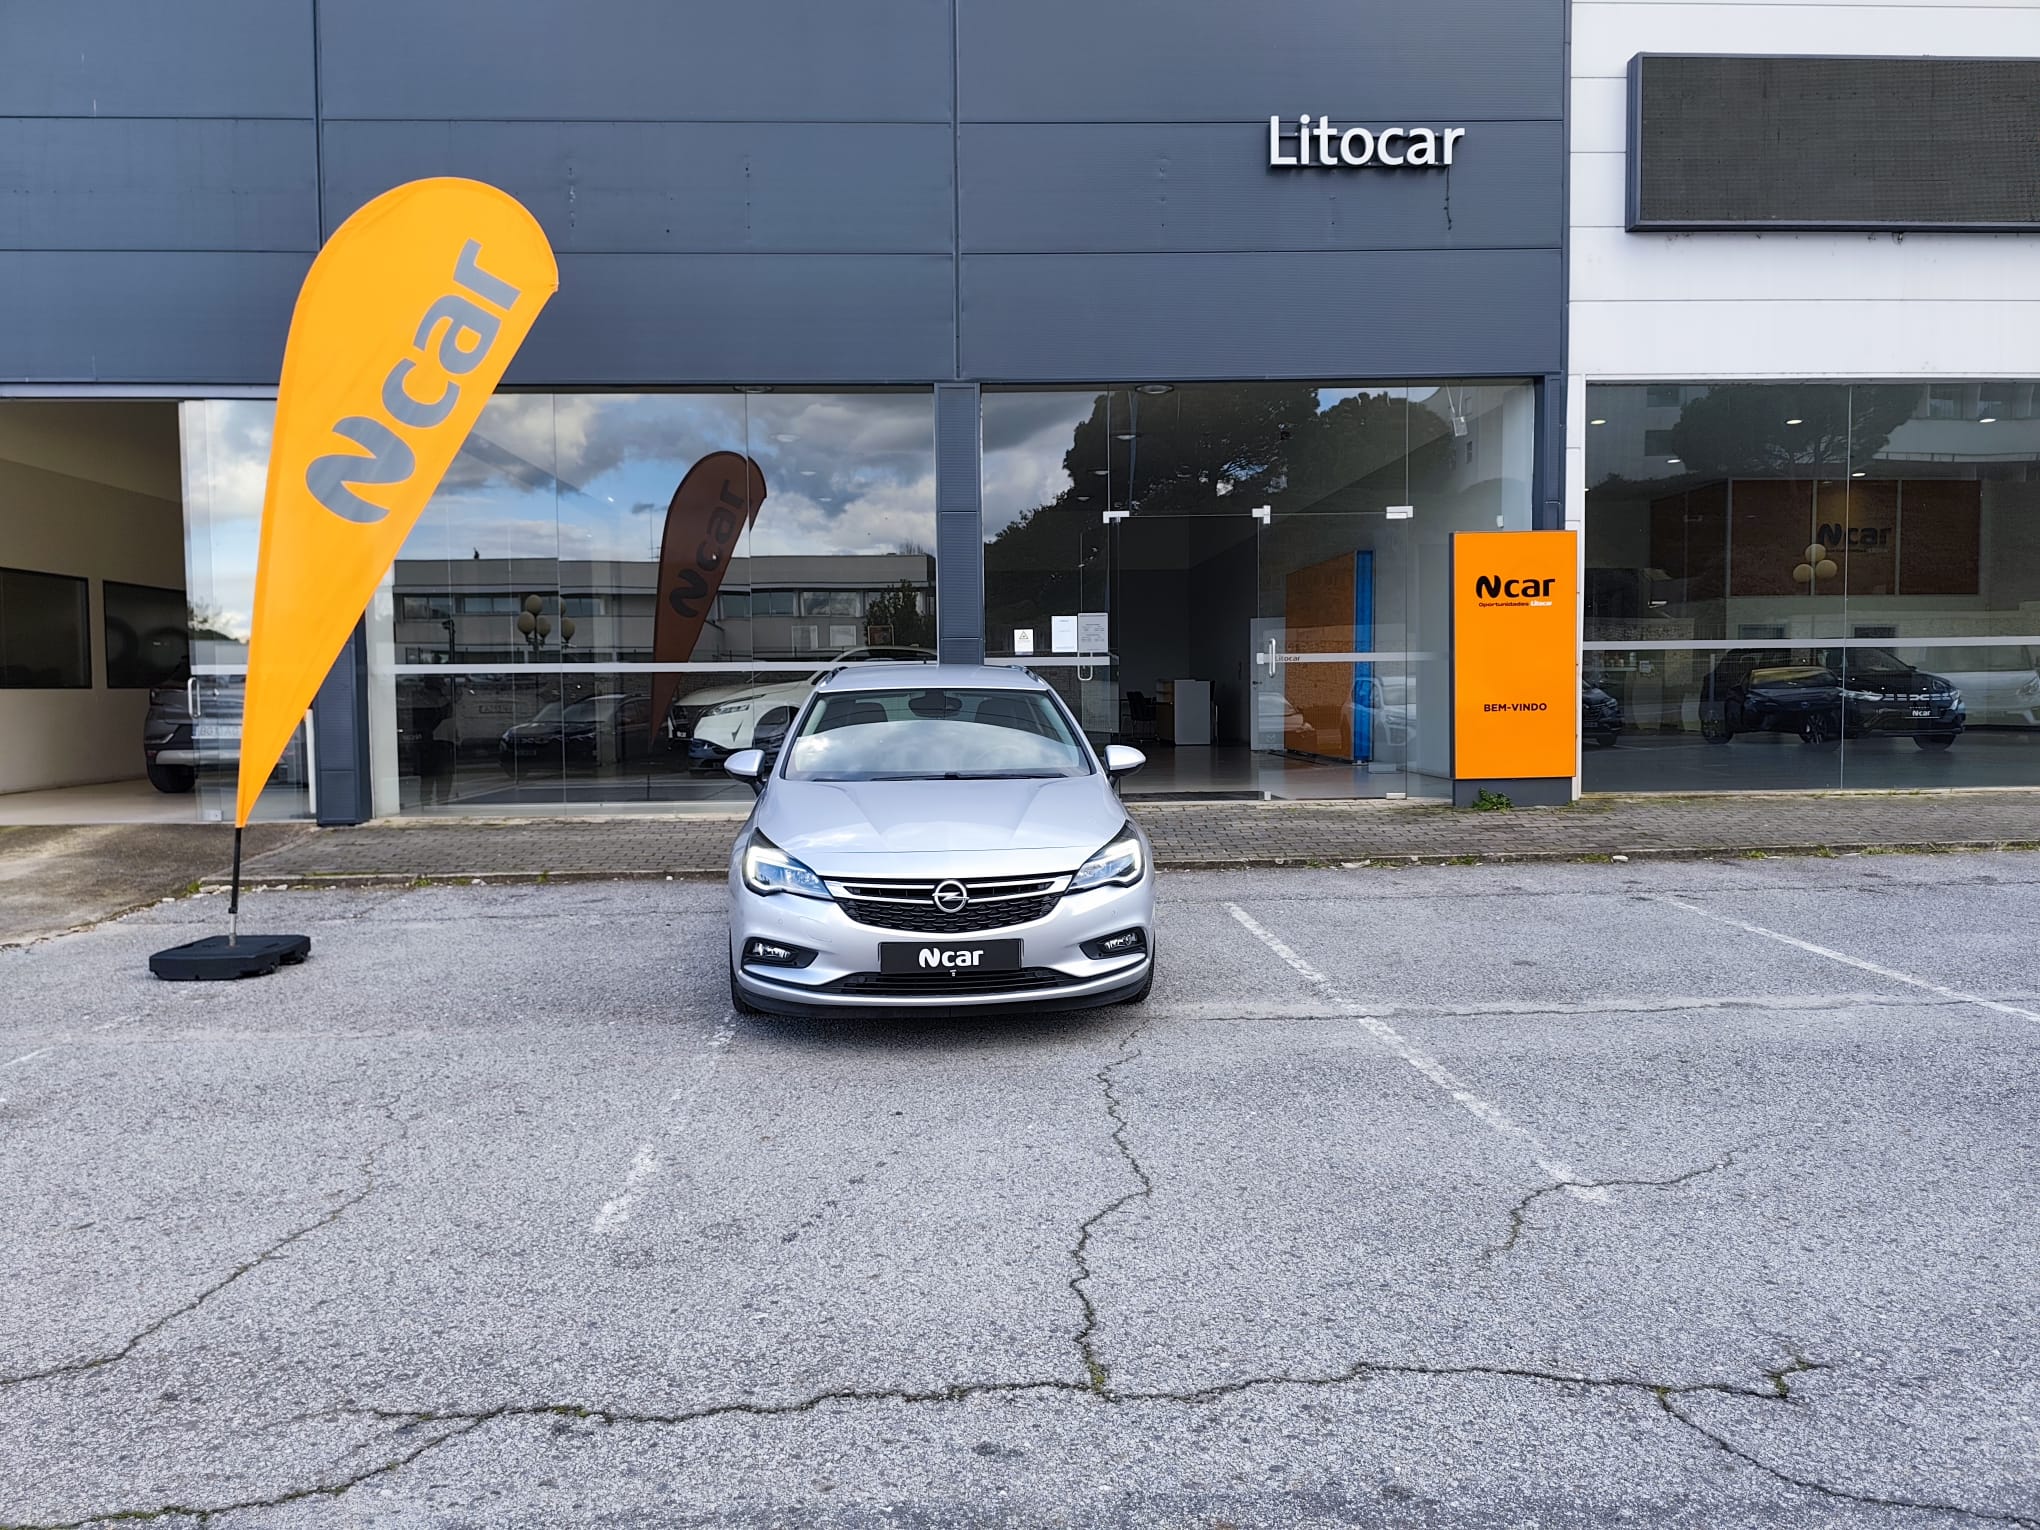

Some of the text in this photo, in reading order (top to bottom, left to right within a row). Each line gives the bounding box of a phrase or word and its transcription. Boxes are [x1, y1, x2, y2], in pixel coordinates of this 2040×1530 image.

[1270, 114, 1465, 165] Litocar
[305, 237, 522, 524] Ncar
[1817, 523, 1892, 546] Ncar
[669, 479, 745, 618] Ncar
[1476, 575, 1556, 599] Ncar
[1484, 703, 1548, 712] BEM-VINDO
[919, 947, 984, 968] Ncar
